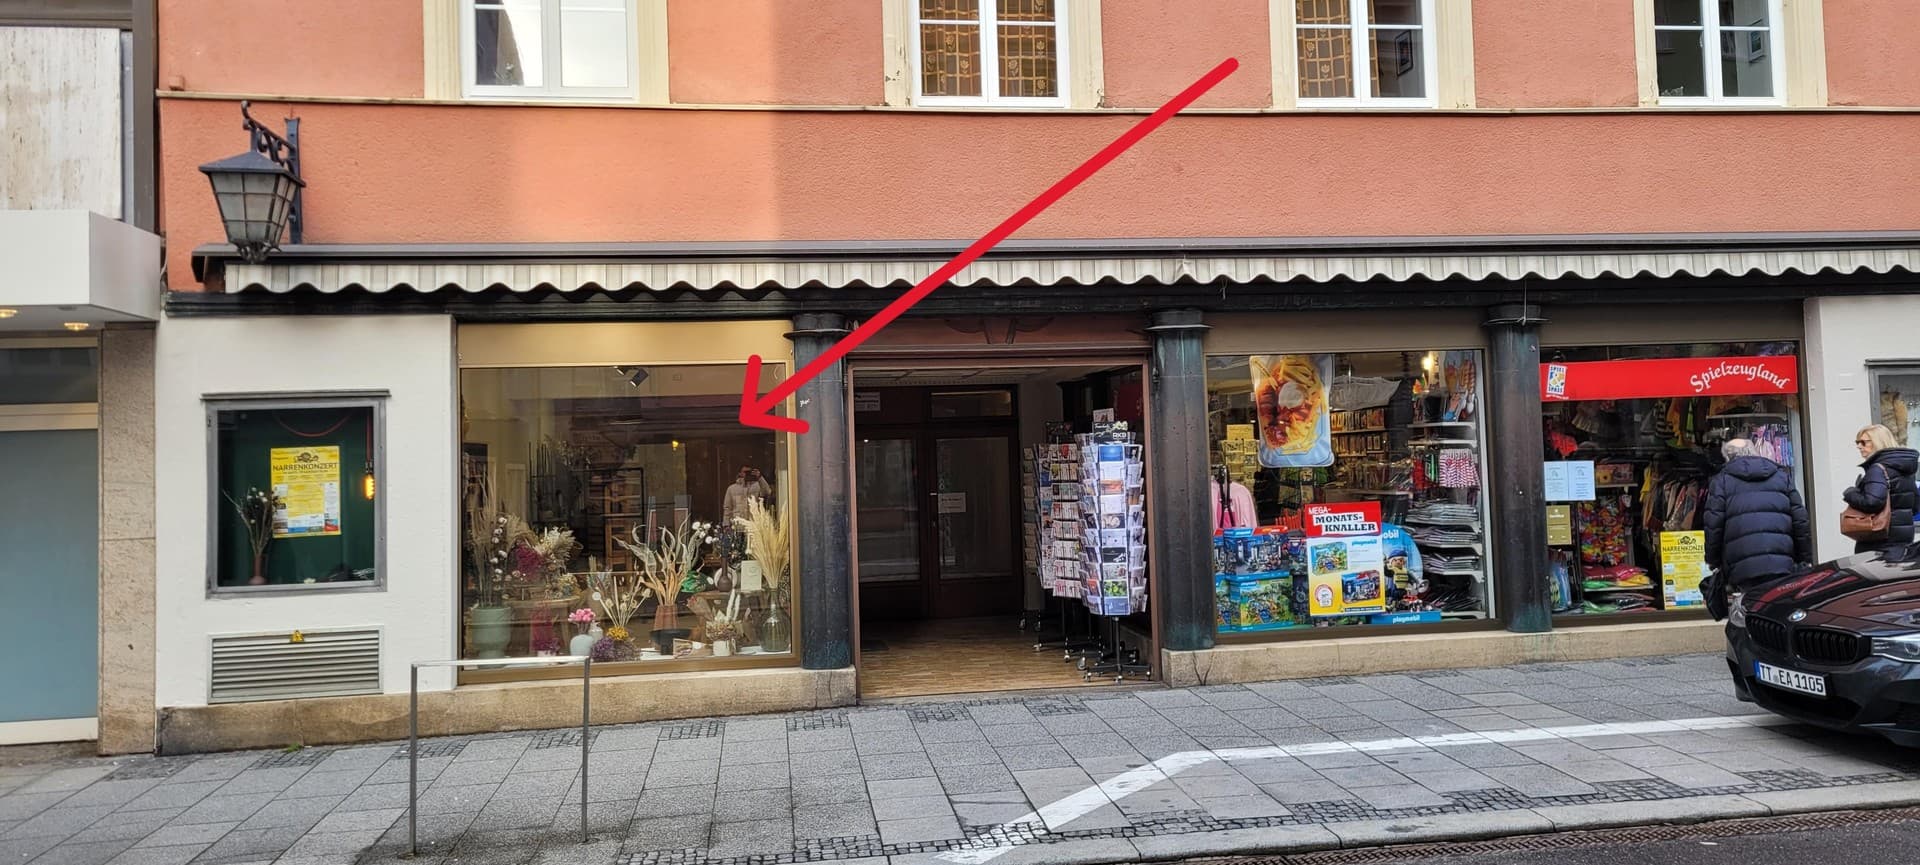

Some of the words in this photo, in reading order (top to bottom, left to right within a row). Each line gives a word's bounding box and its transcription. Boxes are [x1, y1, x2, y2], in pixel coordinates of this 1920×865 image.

[1690, 361, 1790, 393] Spielzeugland
[272, 463, 337, 472] NARRENKONZERT
[1308, 506, 1331, 514] MEGA-
[1315, 513, 1363, 524] MONATS-
[1324, 523, 1376, 532] KNALLER
[1383, 529, 1399, 539] obil
[1760, 665, 1772, 680] TT
[1779, 670, 1793, 687] EA
[1794, 674, 1824, 693] 1105
